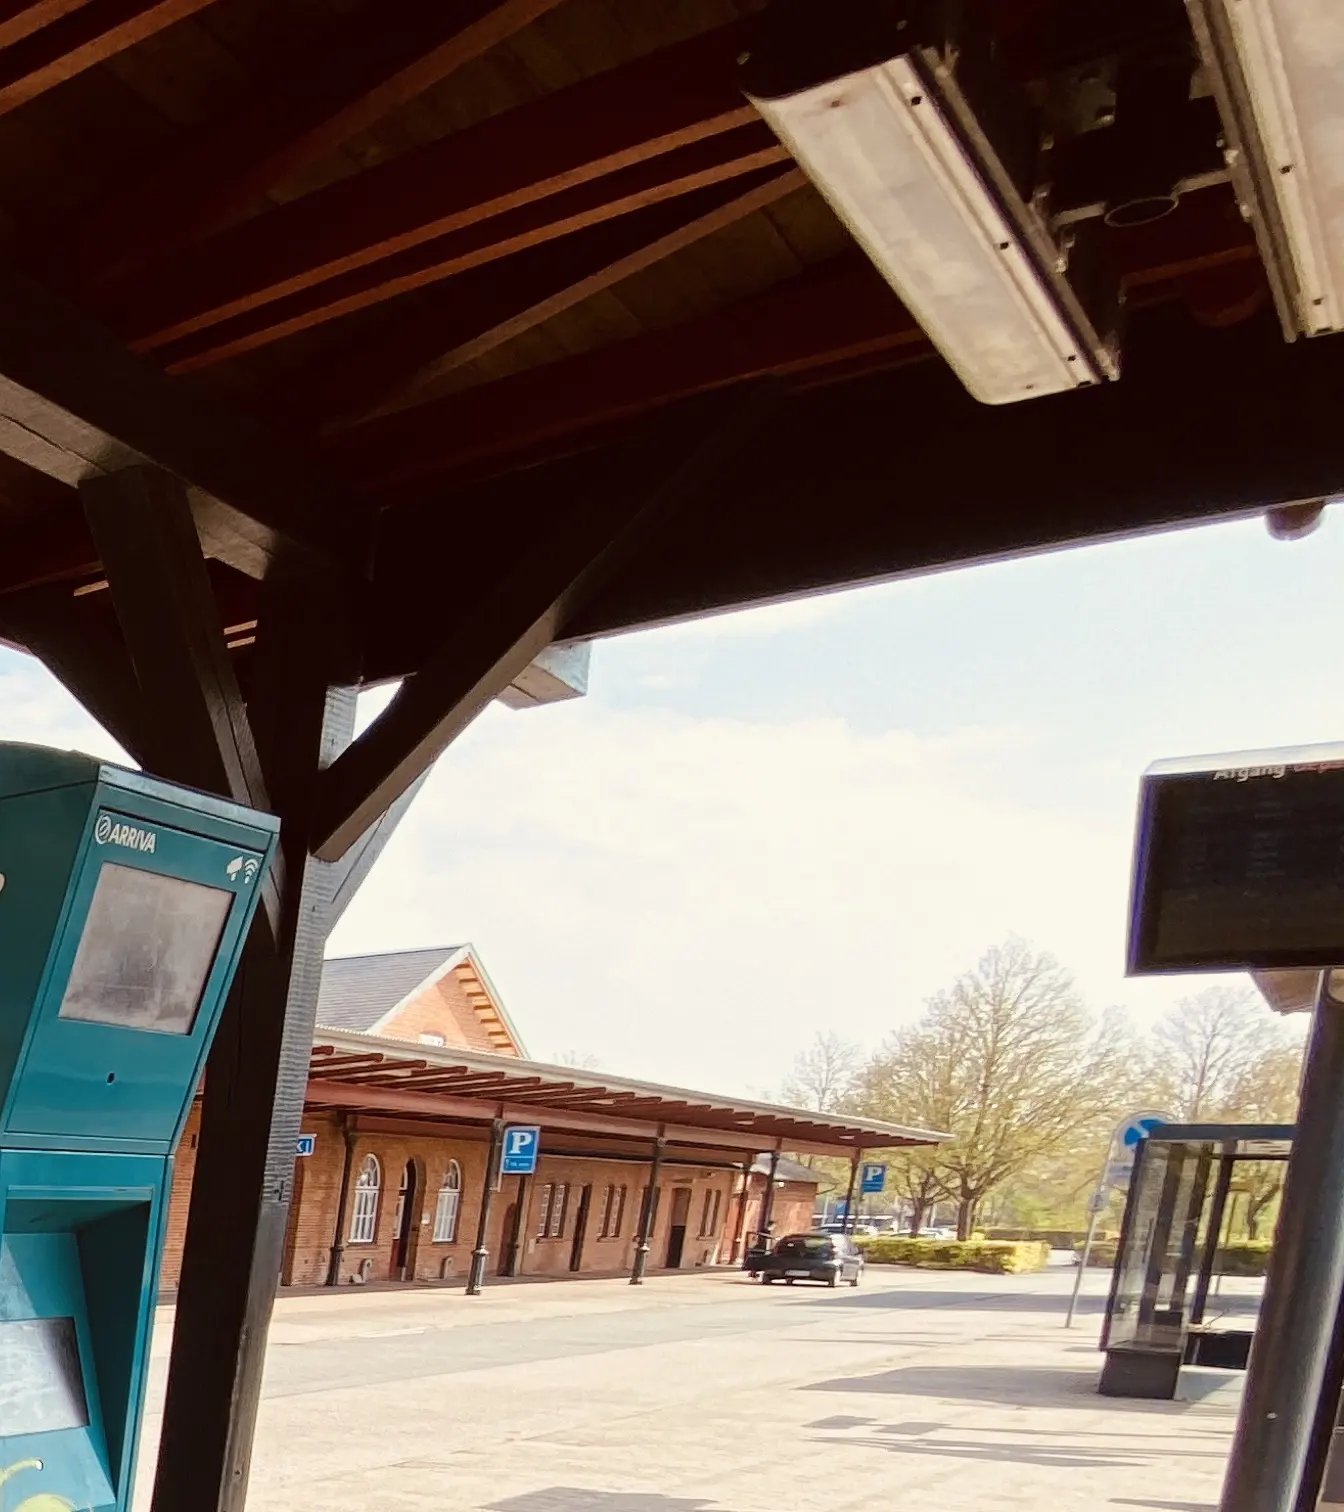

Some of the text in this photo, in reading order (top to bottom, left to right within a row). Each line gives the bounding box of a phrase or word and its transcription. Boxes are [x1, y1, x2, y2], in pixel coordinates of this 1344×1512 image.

[109, 823, 157, 853] ARRIVA
[508, 1132, 532, 1154] P
[866, 1166, 883, 1181] P
